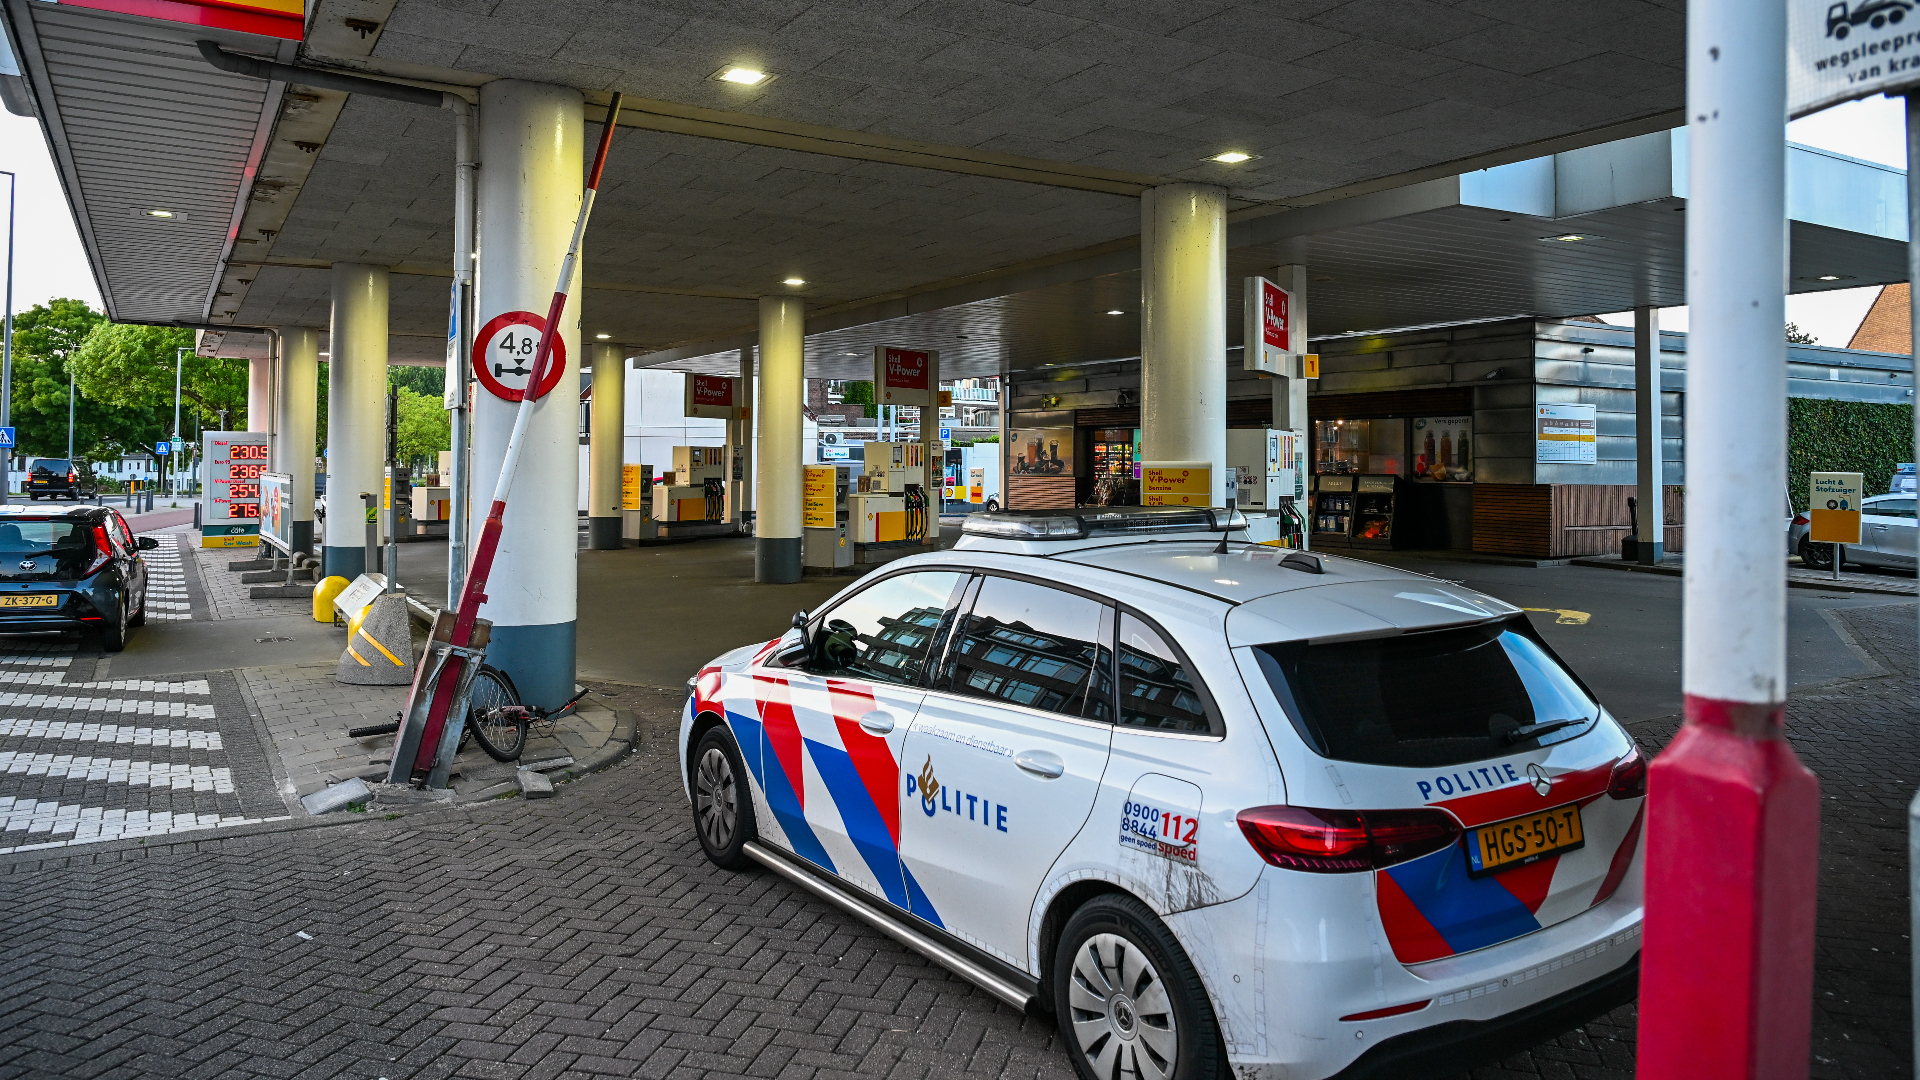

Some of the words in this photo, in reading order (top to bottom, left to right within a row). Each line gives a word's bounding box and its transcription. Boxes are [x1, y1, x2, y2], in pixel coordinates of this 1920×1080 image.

[1848, 65, 1881, 83] van
[499, 332, 532, 356] 4,8
[889, 363, 921, 377] V-Power
[1310, 360, 1315, 372] 1
[942, 395, 947, 403] 3
[1815, 486, 1857, 494] Stofzuiger
[4, 596, 53, 606] ZK-377-G
[919, 724, 955, 742] waakzaam
[966, 735, 1008, 758] dienstbaar
[1416, 763, 1520, 801] POLITIE
[907, 773, 1008, 833] POLITIE
[1124, 801, 1159, 822] 0900
[1121, 817, 1157, 840] 8844
[1162, 812, 1199, 845] 112
[1484, 811, 1574, 862] HGS-50-T
[1120, 834, 1136, 844] geen
[1136, 839, 1157, 850] spoed
[1471, 855, 1481, 865] NL
